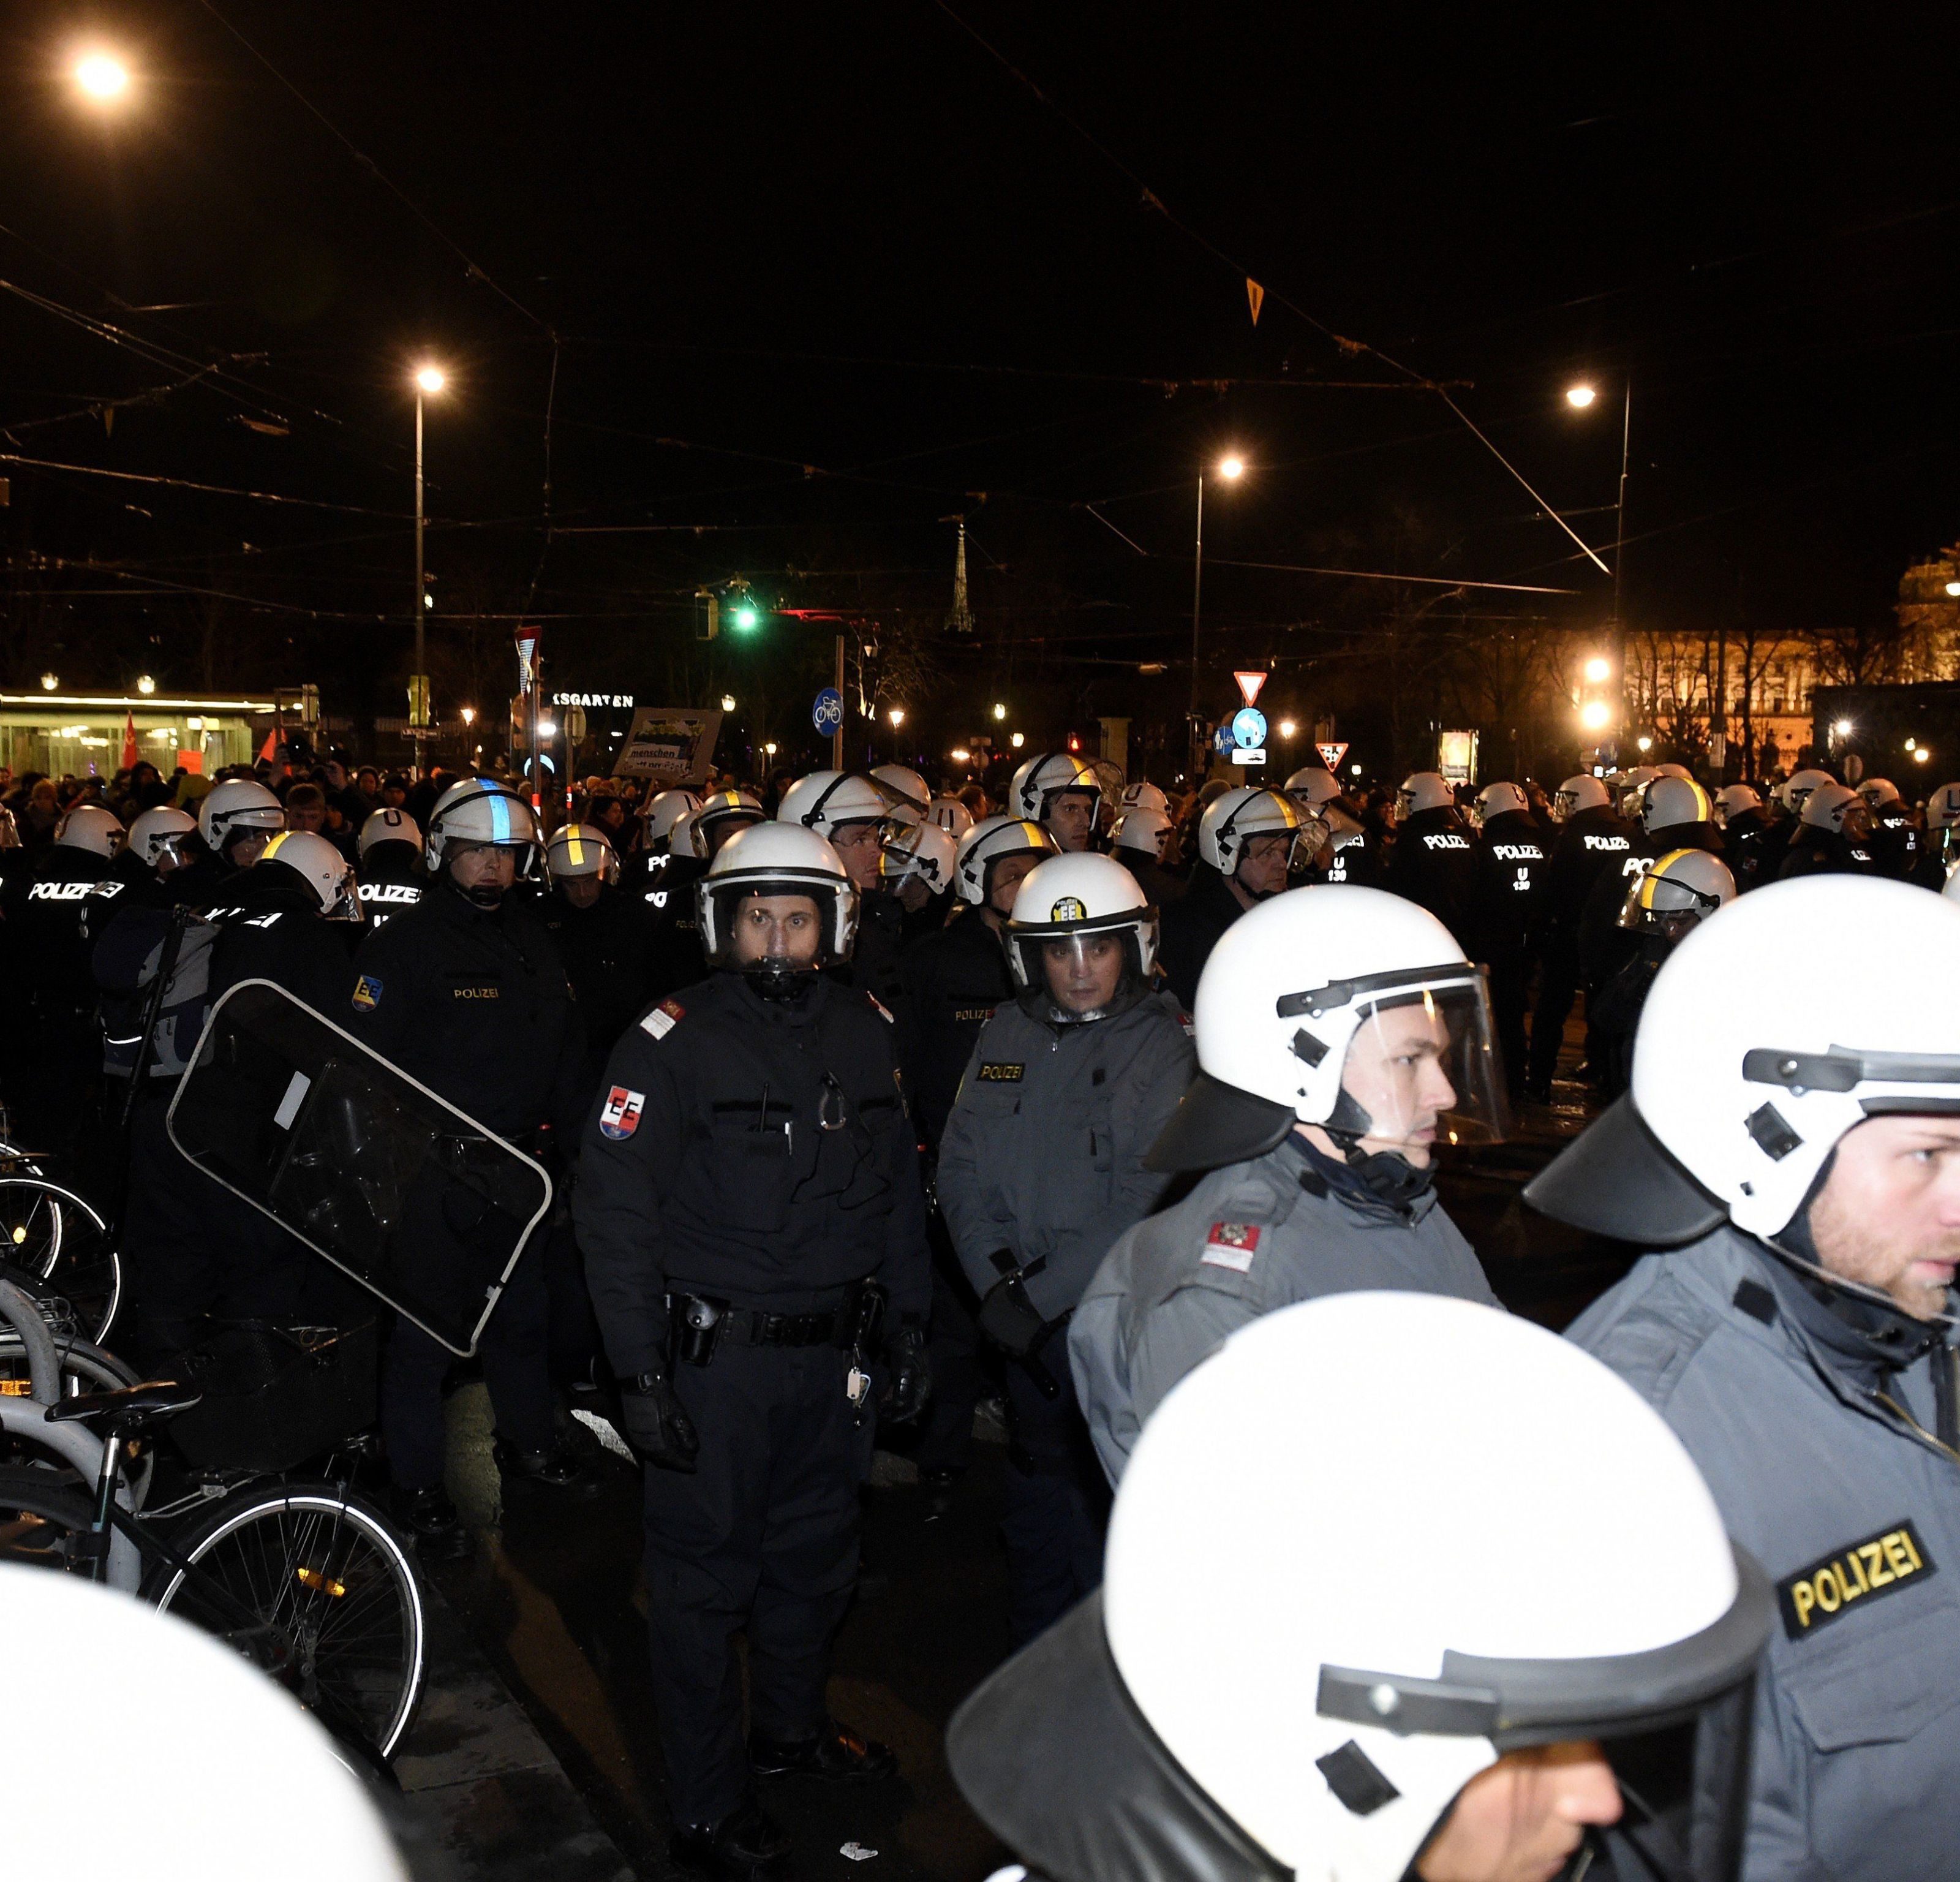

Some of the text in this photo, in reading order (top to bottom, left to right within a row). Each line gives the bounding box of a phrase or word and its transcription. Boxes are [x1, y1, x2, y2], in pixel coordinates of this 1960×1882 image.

[631, 749, 675, 758] menschen
[1334, 857, 1344, 869] U
[1328, 870, 1347, 882] 130
[1517, 867, 1528, 881] U
[1513, 881, 1530, 891] 130
[357, 884, 421, 904] OLIZE
[358, 983, 380, 999] EE
[454, 988, 499, 999] POLIZEI
[981, 1066, 1022, 1079] POLIZEI
[609, 1097, 639, 1121] EE
[1791, 1529, 1923, 1628] POLIZEI
